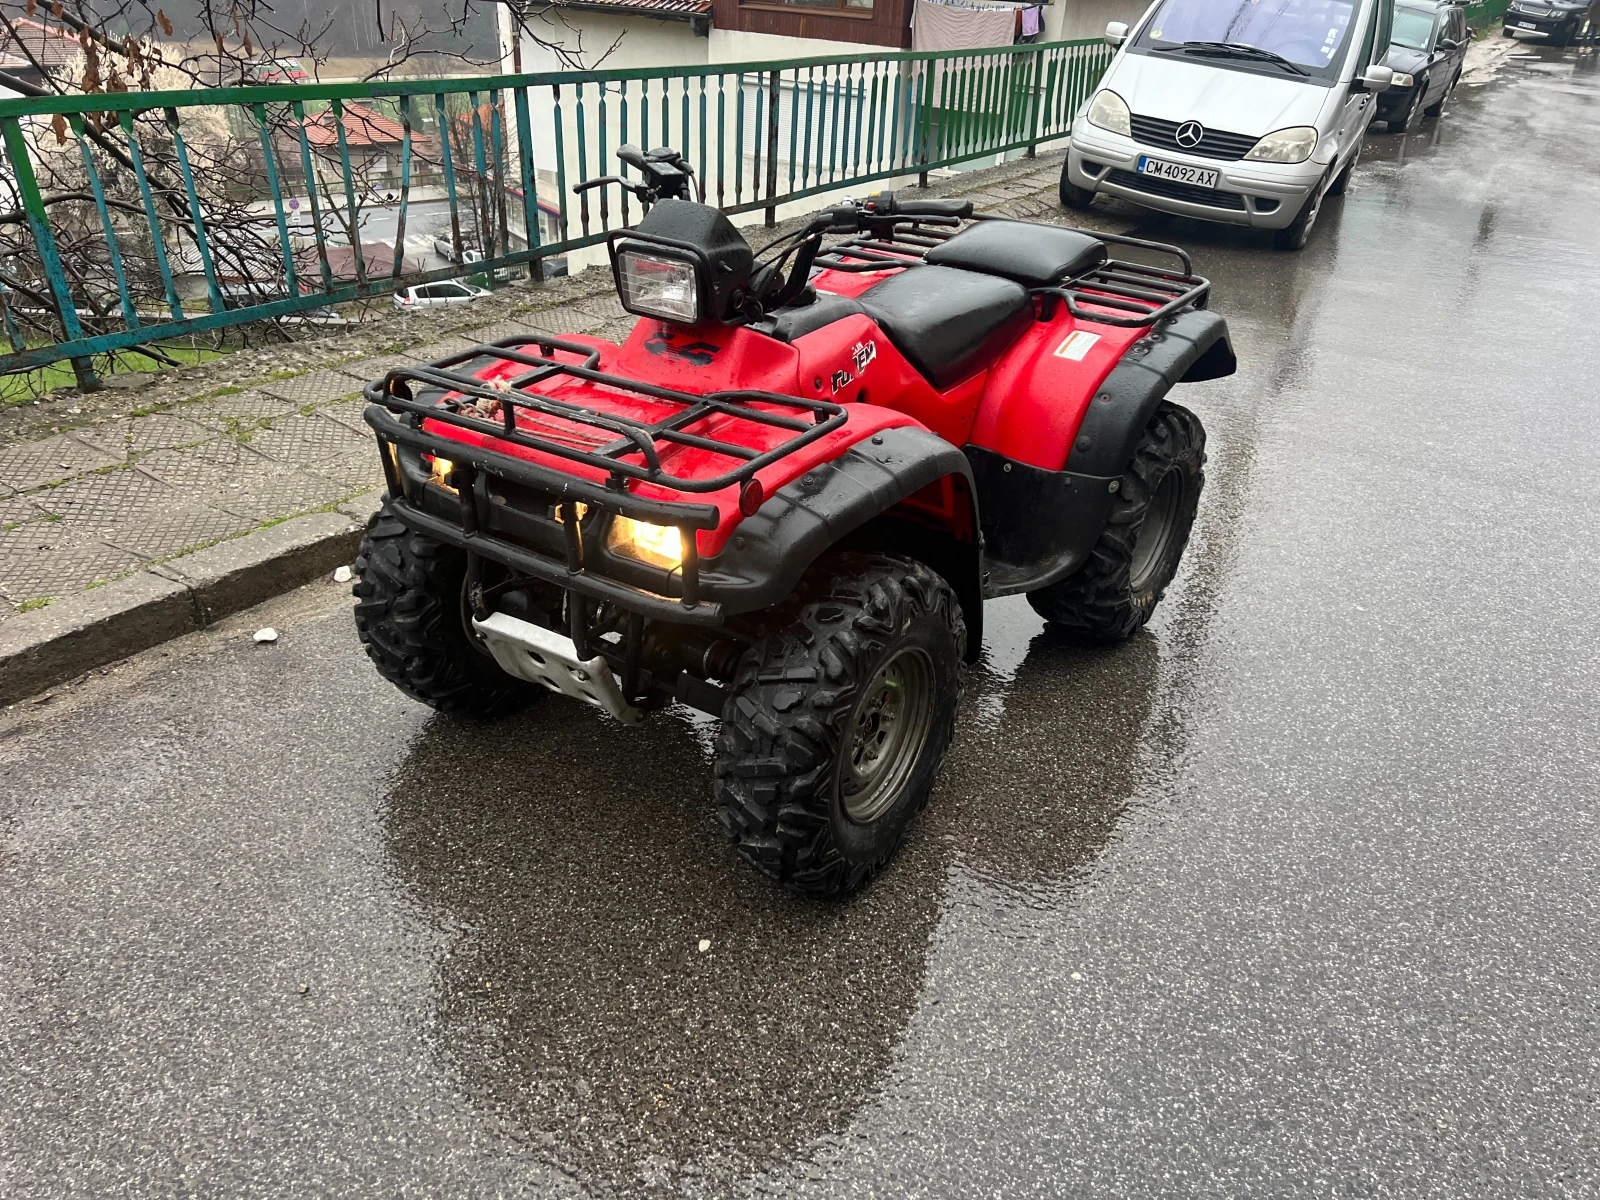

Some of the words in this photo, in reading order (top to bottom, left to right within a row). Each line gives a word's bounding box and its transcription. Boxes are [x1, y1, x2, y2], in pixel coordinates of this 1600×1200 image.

[1146, 160, 1163, 176] CM
[1164, 164, 1195, 182] 4092
[1196, 171, 1215, 186] AX
